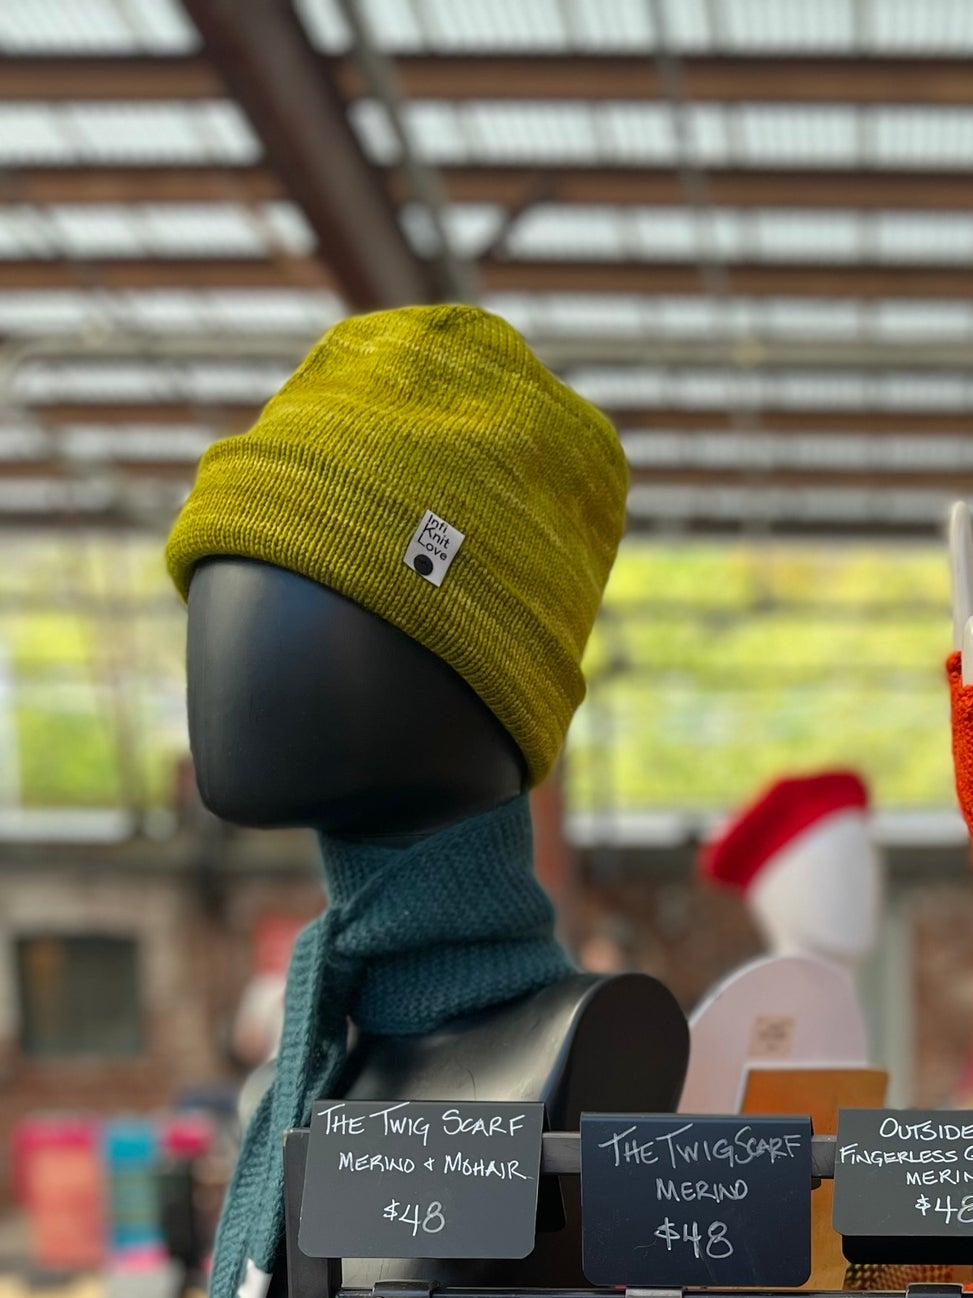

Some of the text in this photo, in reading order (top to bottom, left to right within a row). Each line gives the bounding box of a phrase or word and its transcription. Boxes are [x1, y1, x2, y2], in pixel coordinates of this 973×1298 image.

[423, 523, 450, 549] Knit
[429, 514, 448, 533] Infi
[418, 533, 447, 560] Love
[317, 1102, 526, 1146] THE TWIG SCARF
[598, 1126, 658, 1167] THE
[839, 1143, 959, 1167] FINGERLESS
[338, 1152, 415, 1173] MERINO
[444, 1152, 528, 1180] MOHAIR
[656, 1178, 748, 1203] MERINO
[383, 1199, 446, 1236] $48
[654, 1217, 734, 1259] $48
